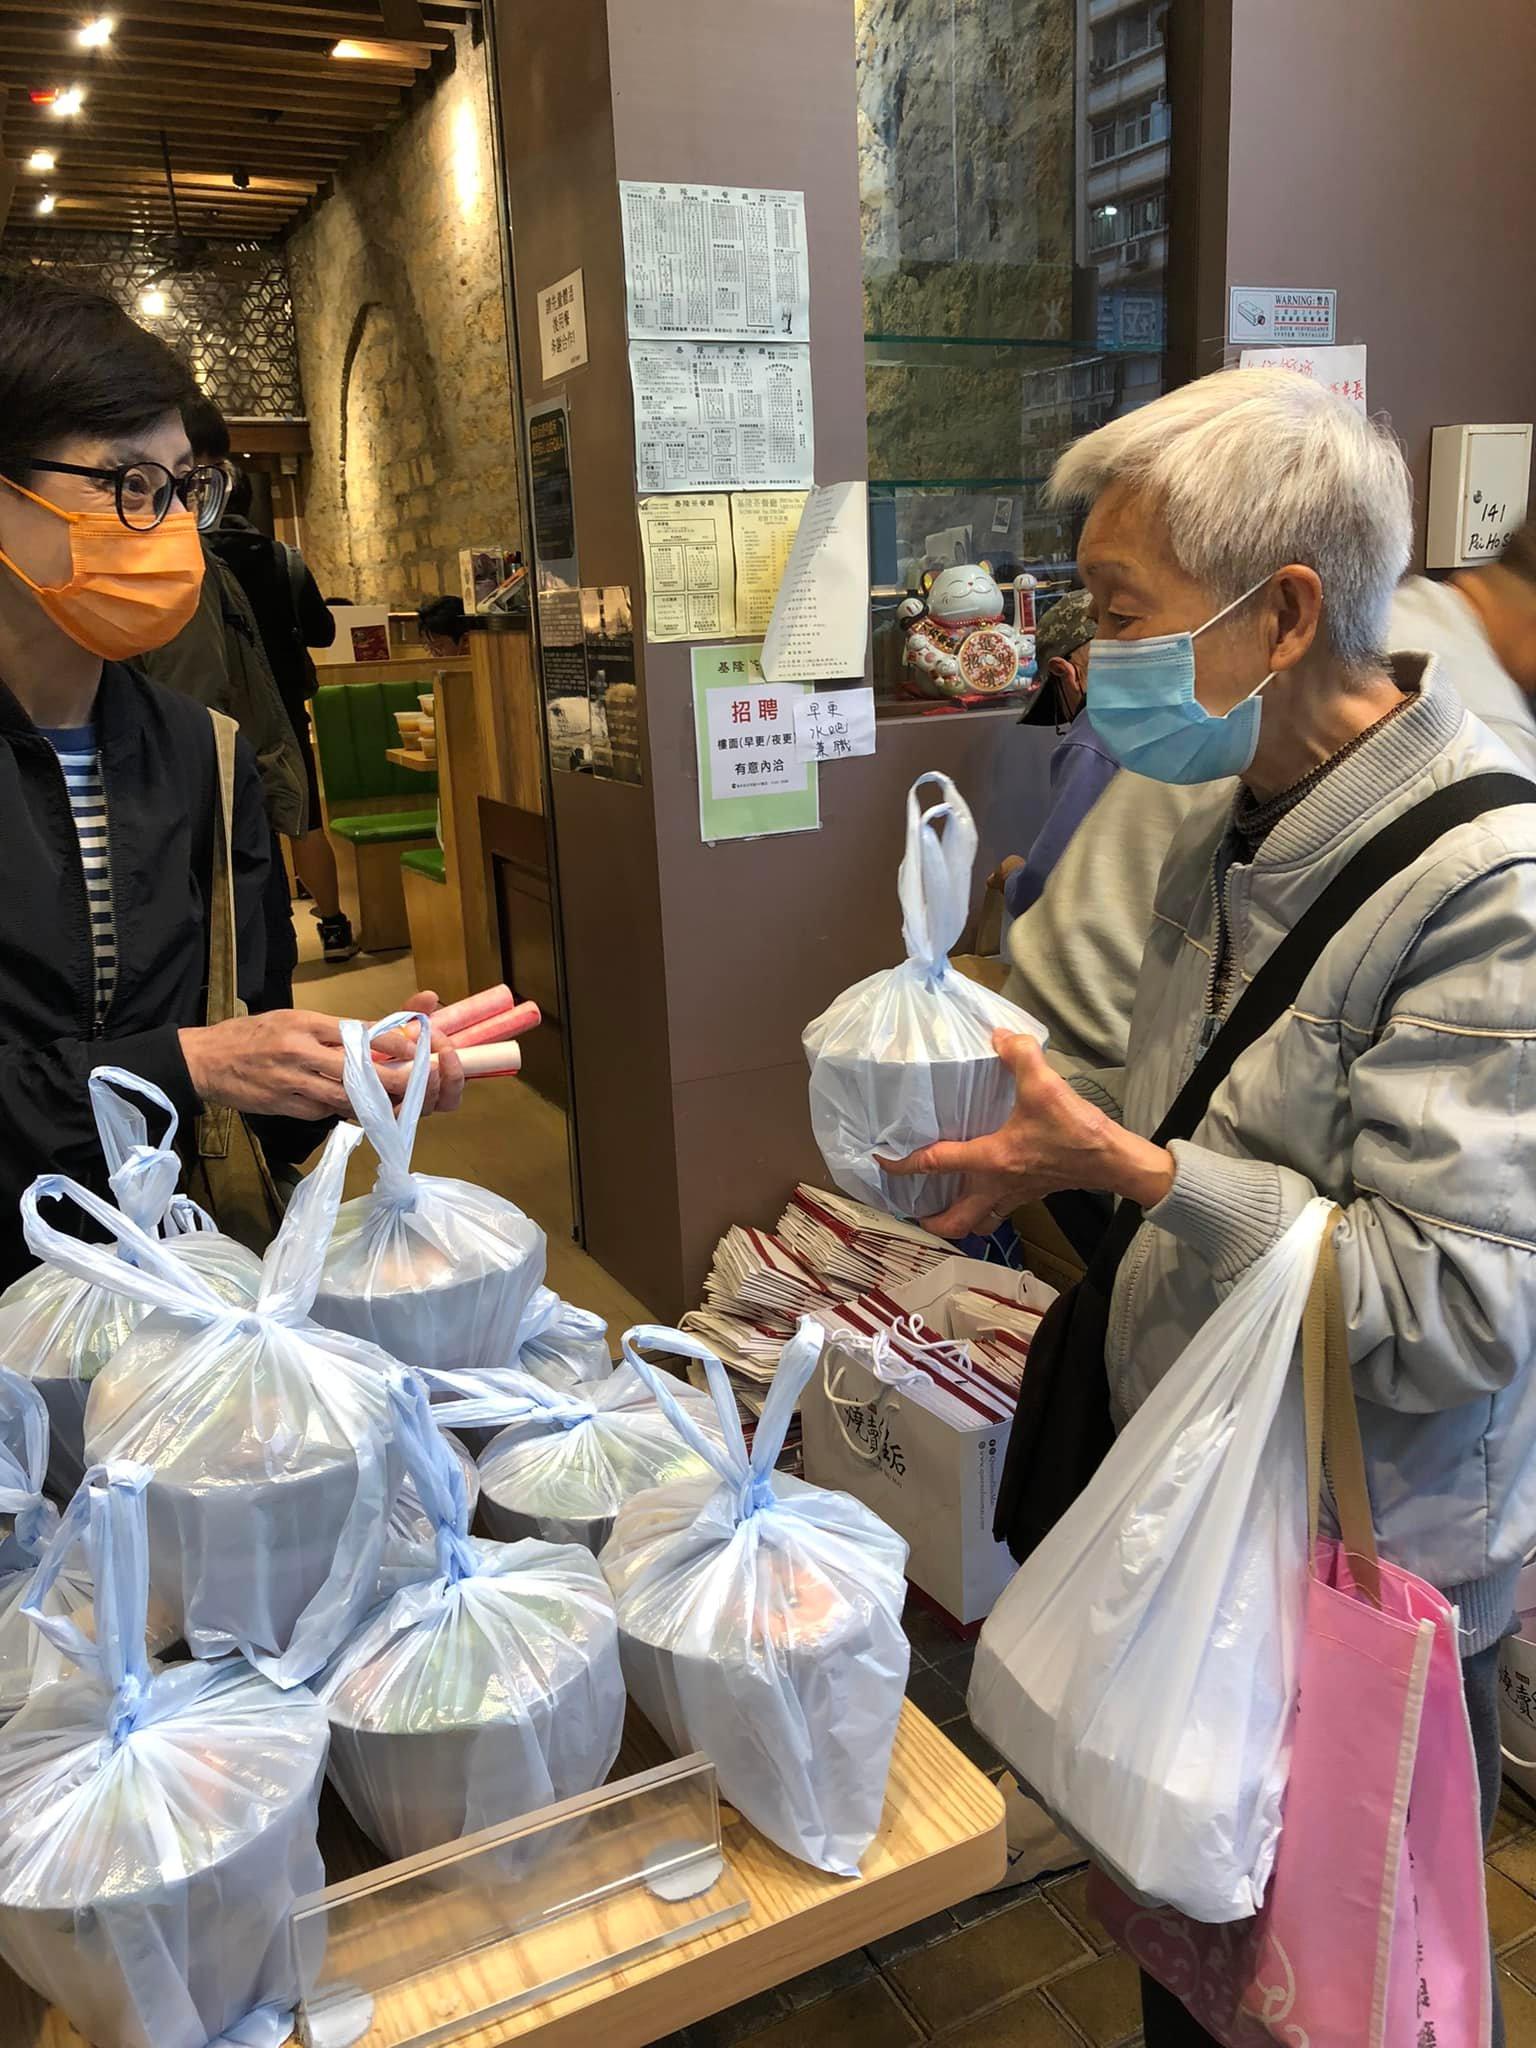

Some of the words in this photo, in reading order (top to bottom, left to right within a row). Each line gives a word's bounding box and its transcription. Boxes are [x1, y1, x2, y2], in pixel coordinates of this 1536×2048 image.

[1275, 295, 1315, 306] WARNING:
[1481, 503, 1506, 522] 141
[731, 698, 779, 724] 招聘
[807, 701, 844, 721] 早更
[810, 722, 849, 740] 水吧
[734, 759, 785, 776] 有意內洽
